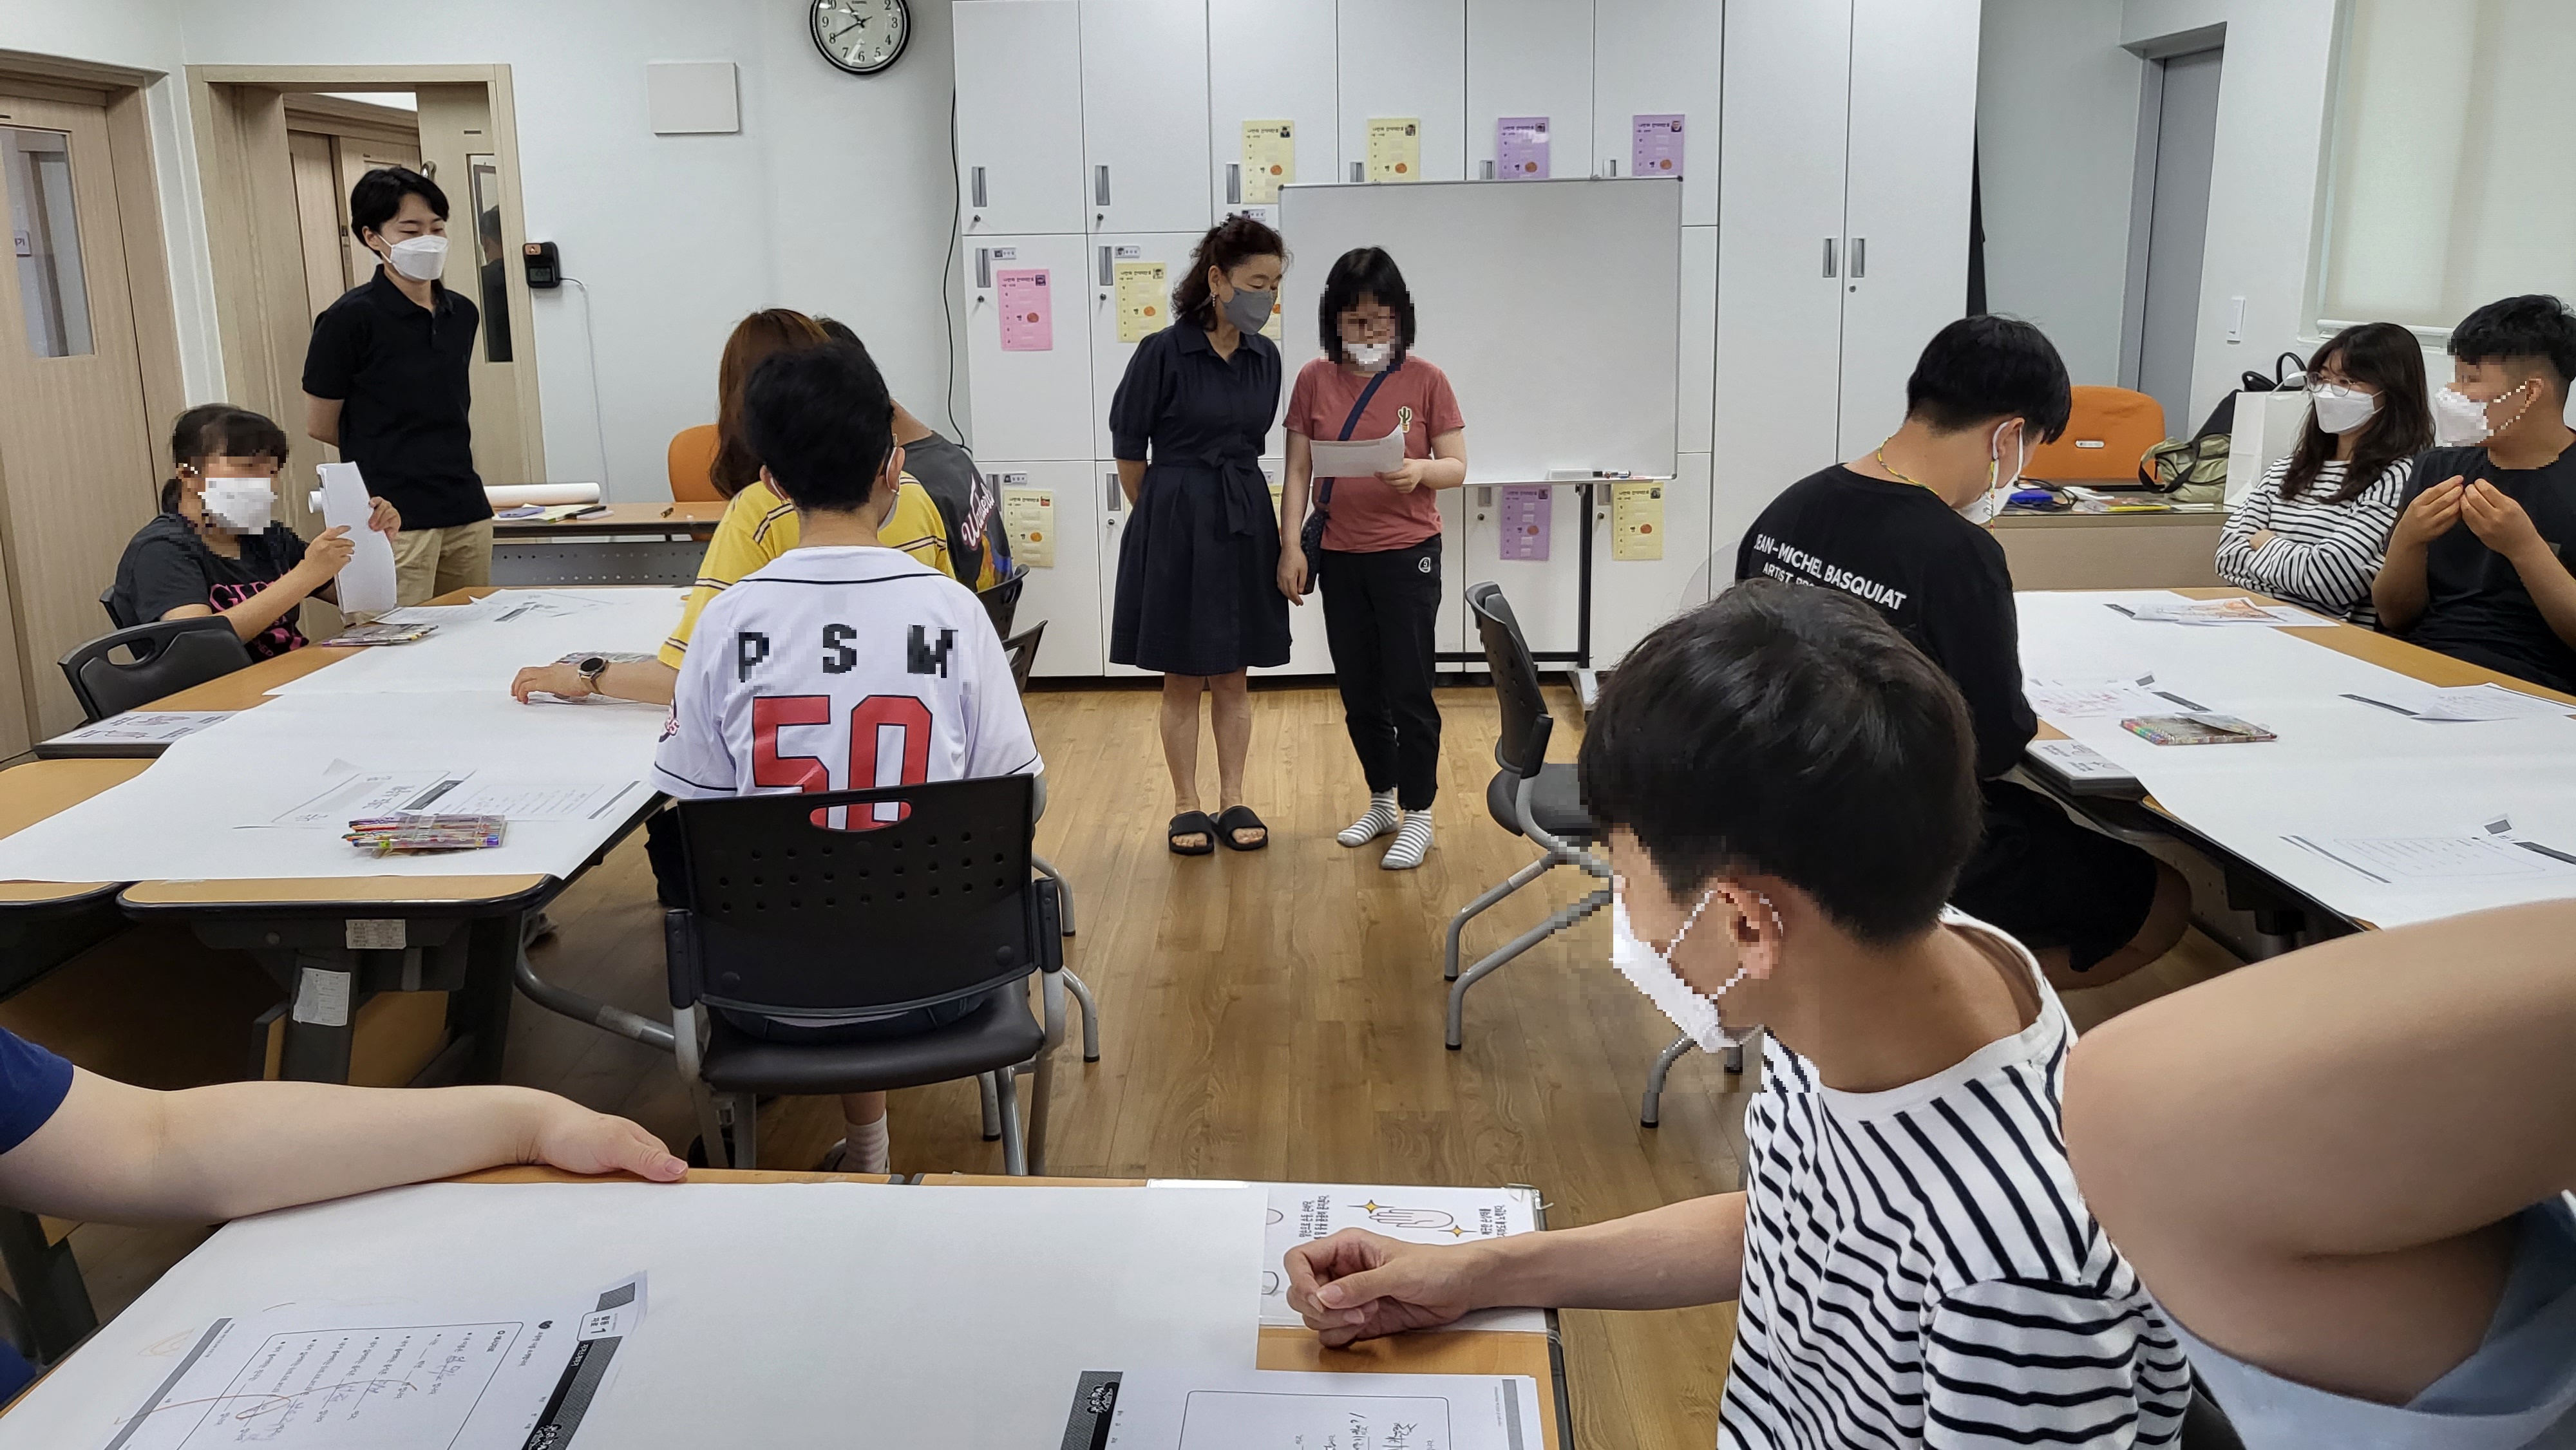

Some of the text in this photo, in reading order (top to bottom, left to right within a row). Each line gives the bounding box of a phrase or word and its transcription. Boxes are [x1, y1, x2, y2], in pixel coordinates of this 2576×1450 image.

[884, 0, 891, 10] 2
[822, 17, 829, 28] 9
[892, 17, 898, 28] 3
[829, 33, 836, 44] 8
[886, 34, 892, 45] 4
[842, 47, 849, 59] 7
[858, 52, 865, 62] 6
[875, 47, 881, 57] 5
[1754, 533, 1907, 610] EAN-MICHEL BASQUIAT
[1762, 562, 1794, 584] ARTIST
[753, 695, 932, 830] 50
[1495, 1221, 1508, 1238] 지하도록
[591, 1317, 600, 1326] 자료
[600, 1315, 610, 1325] 활동
[571, 1344, 589, 1367] 자기소개하기
